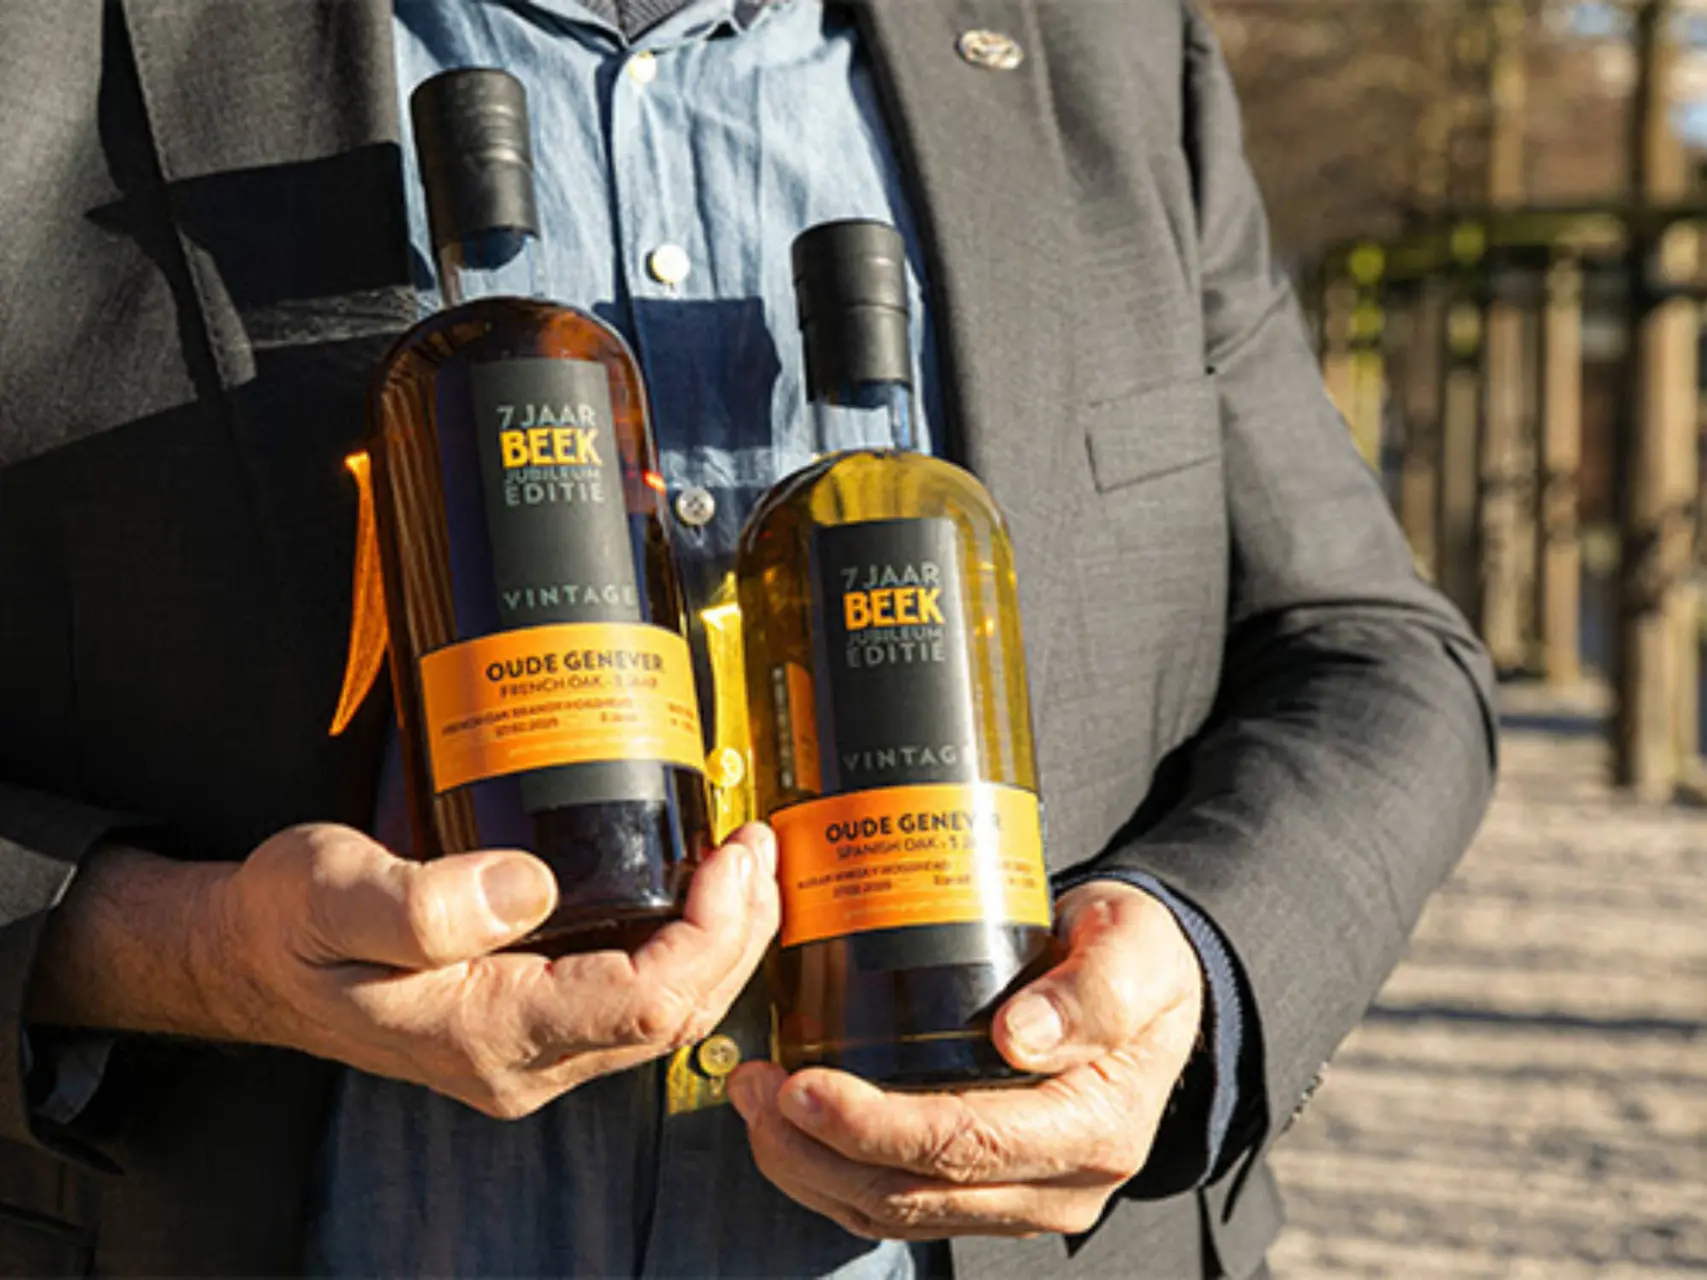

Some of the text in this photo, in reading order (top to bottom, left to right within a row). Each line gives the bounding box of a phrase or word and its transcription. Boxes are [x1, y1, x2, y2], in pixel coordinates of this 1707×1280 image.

[496, 403, 596, 429] 7 JAAR
[501, 427, 602, 467] BEEK
[504, 481, 604, 506] EDITIE
[840, 561, 940, 590] 7 JAAR
[503, 584, 638, 609] VINTAGE
[844, 587, 944, 630] BEEK
[485, 650, 665, 682] OUDE GENEVER
[846, 641, 946, 668] EDITIE
[500, 677, 565, 698] FRENCH
[567, 673, 601, 690] OAK
[843, 745, 968, 771] VINTAG
[825, 811, 1004, 844] OUDE GENEVR
[836, 839, 899, 861] SPANISH
[904, 837, 937, 851] OAK
